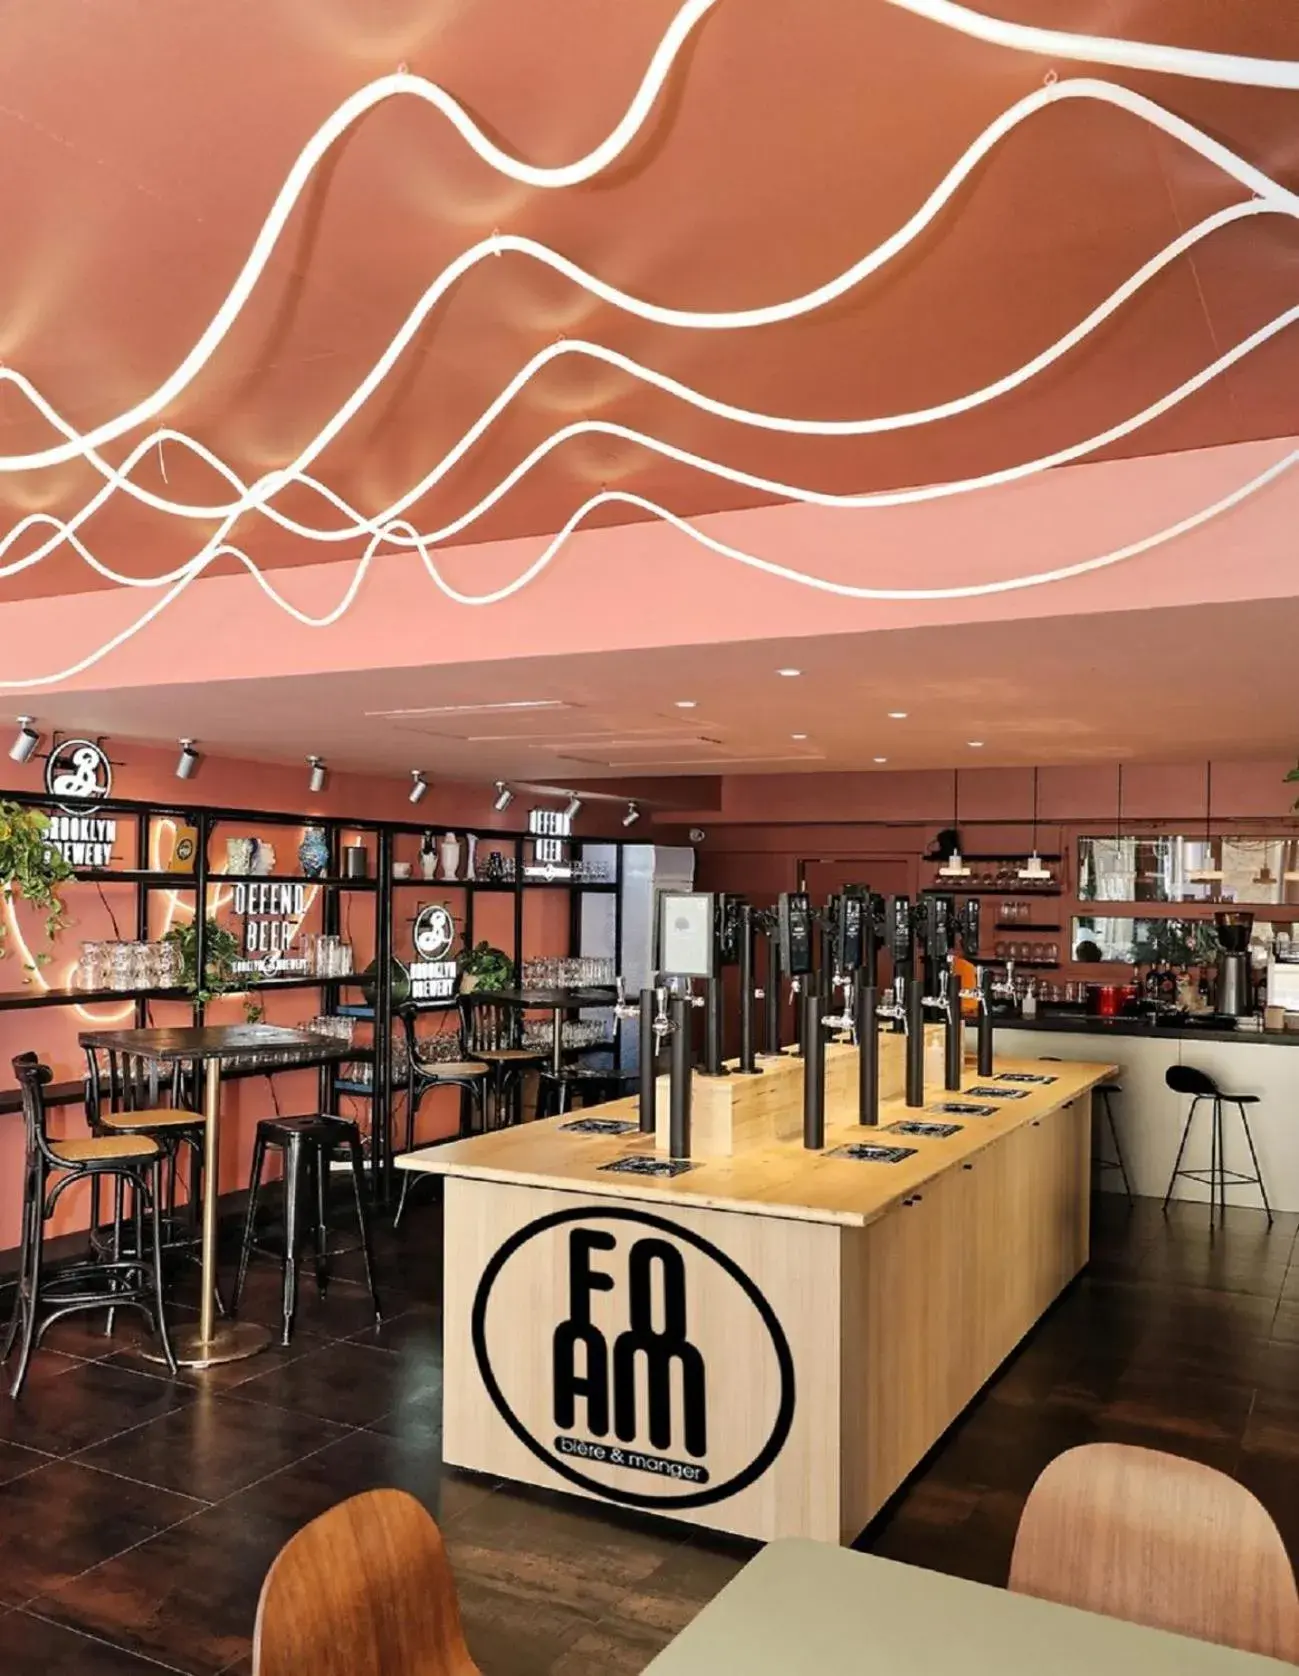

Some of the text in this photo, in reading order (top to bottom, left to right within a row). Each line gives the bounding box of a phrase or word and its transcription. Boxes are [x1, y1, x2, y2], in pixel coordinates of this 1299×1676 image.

[43, 840, 112, 866] EWERY
[235, 882, 304, 915] DEFEND
[247, 920, 290, 952] BEER
[560, 1437, 702, 1480] bière & manger
